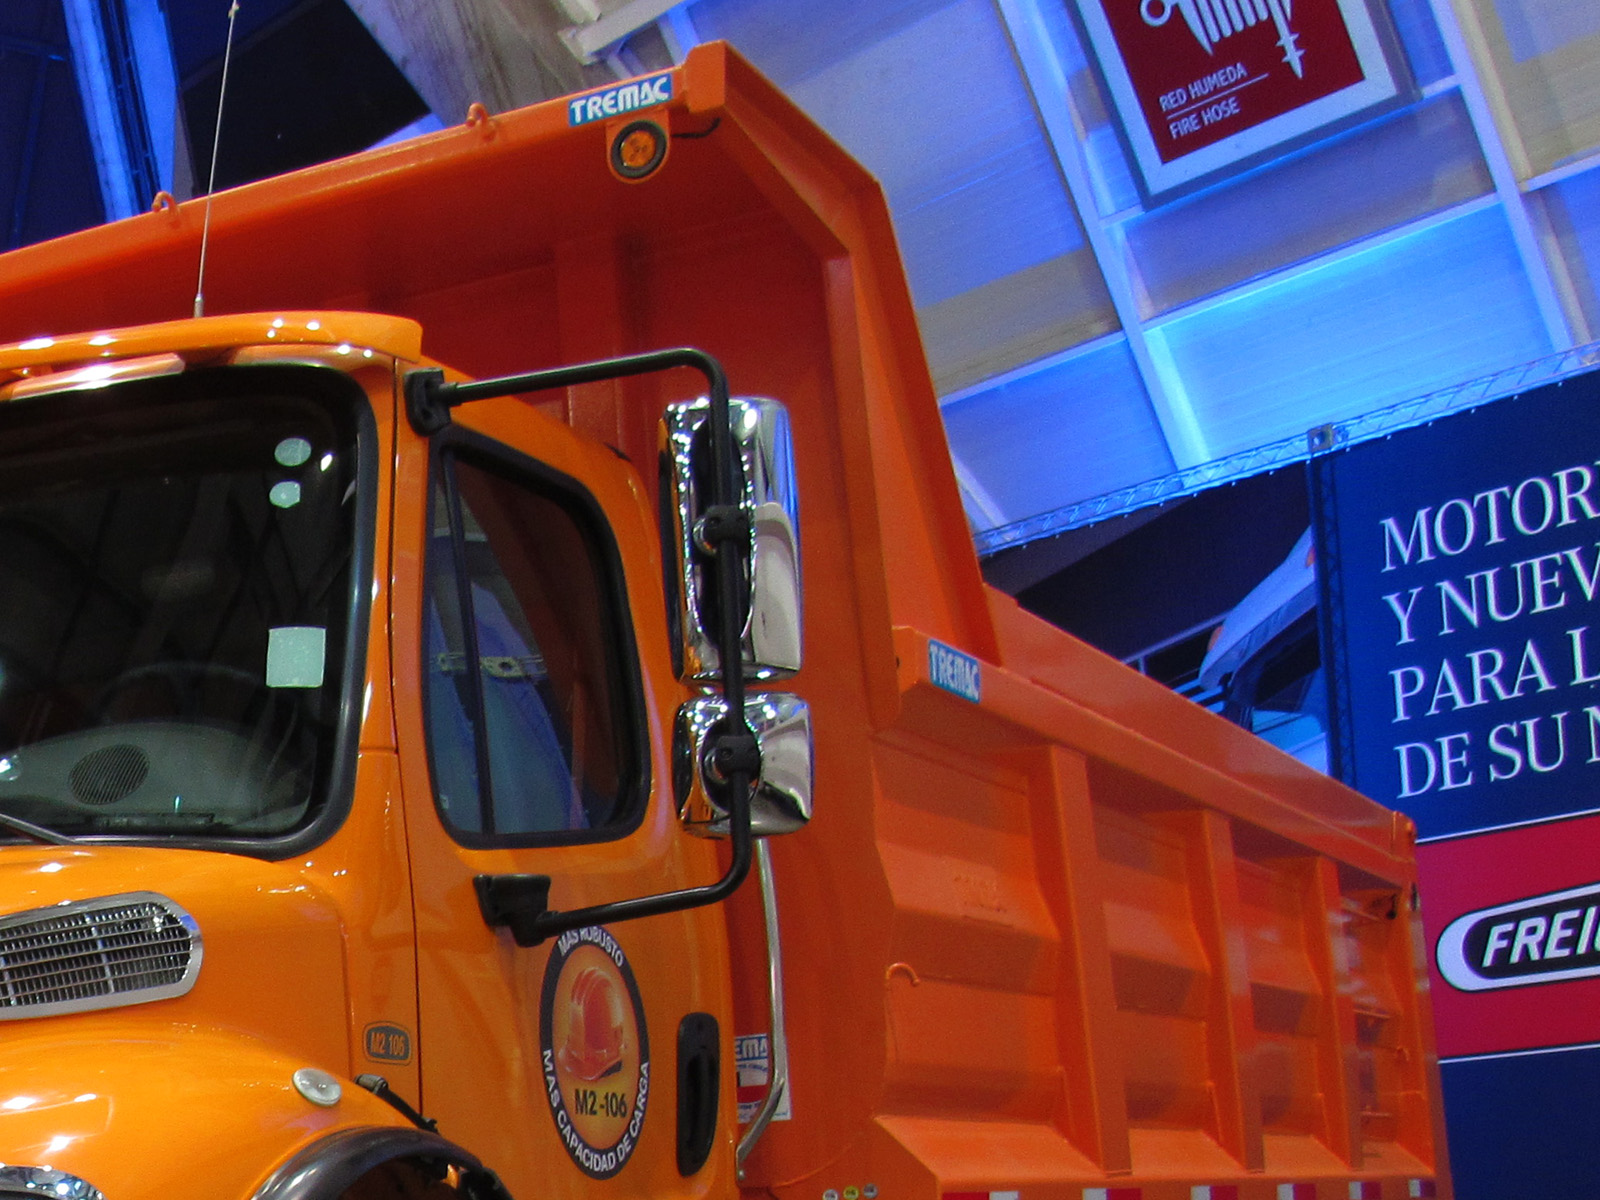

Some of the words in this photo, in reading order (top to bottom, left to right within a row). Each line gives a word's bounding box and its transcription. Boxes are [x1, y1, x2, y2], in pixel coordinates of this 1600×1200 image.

[570, 77, 669, 123] TREMAC
[1159, 88, 1187, 112] RED
[1188, 62, 1247, 99] HUMEDA
[1169, 113, 1201, 139] FIRE
[1201, 96, 1241, 126] HOSE
[1379, 460, 1600, 573] MOTOR
[1382, 587, 1422, 646] Y
[930, 644, 979, 700] TREMAC
[1388, 639, 1557, 723] PARA
[1394, 732, 1473, 799] DE
[1488, 711, 1570, 782] SU
[580, 926, 623, 967] ROBUSTO
[1482, 904, 1600, 968] FREI
[543, 1049, 559, 1102] MAS
[557, 1112, 617, 1172] CAPACIDAD
[615, 1138, 632, 1161] DE
[629, 1062, 649, 1138] CARGA
[574, 1089, 628, 1118] M2-106
